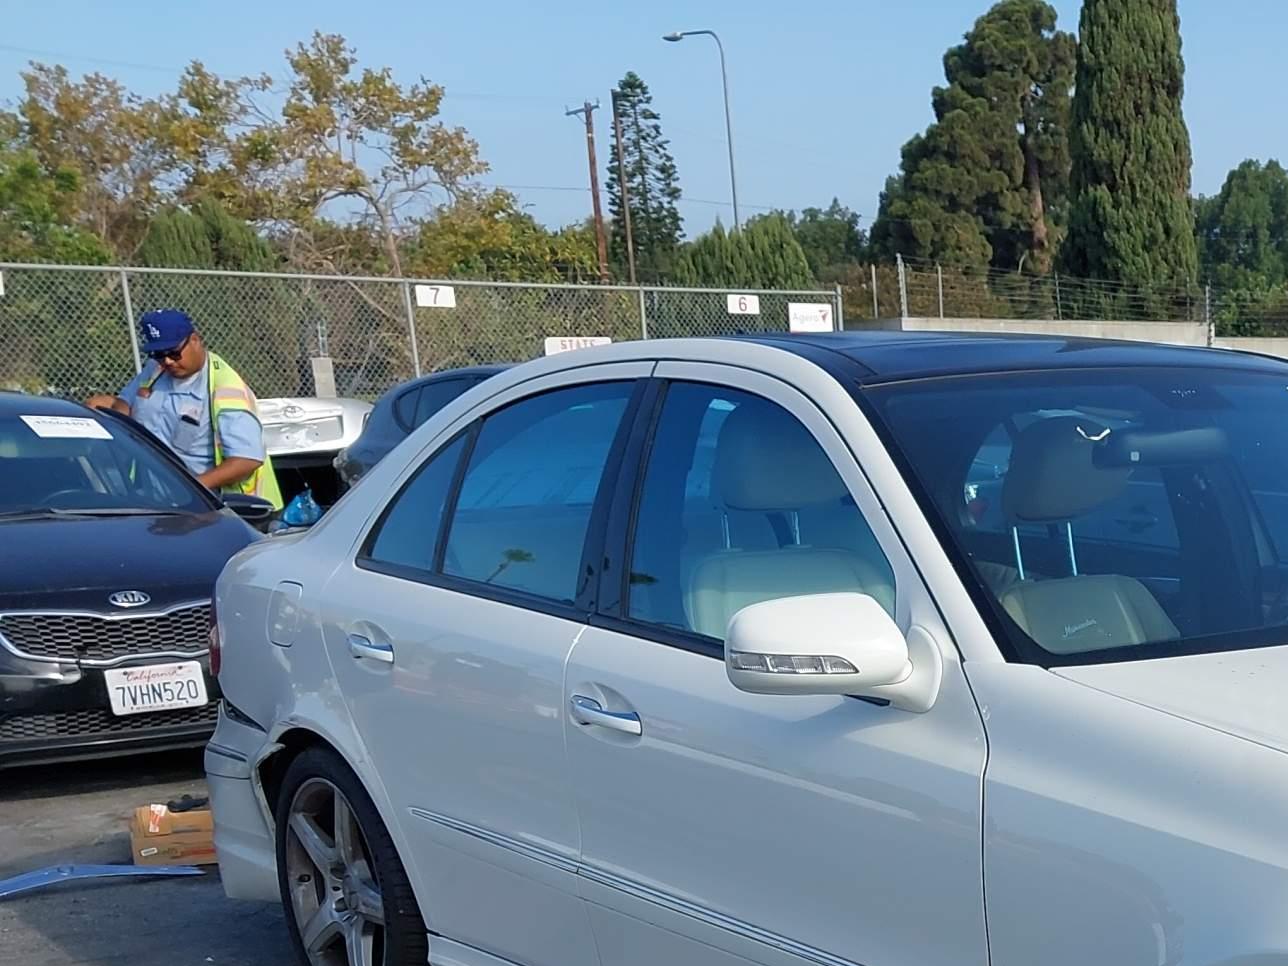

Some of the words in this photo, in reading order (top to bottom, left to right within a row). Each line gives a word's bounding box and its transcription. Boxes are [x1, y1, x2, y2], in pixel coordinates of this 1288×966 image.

[430, 287, 440, 305] 7
[738, 296, 748, 312] 6
[112, 591, 148, 603] KIA
[115, 679, 199, 707] 7VHN520
